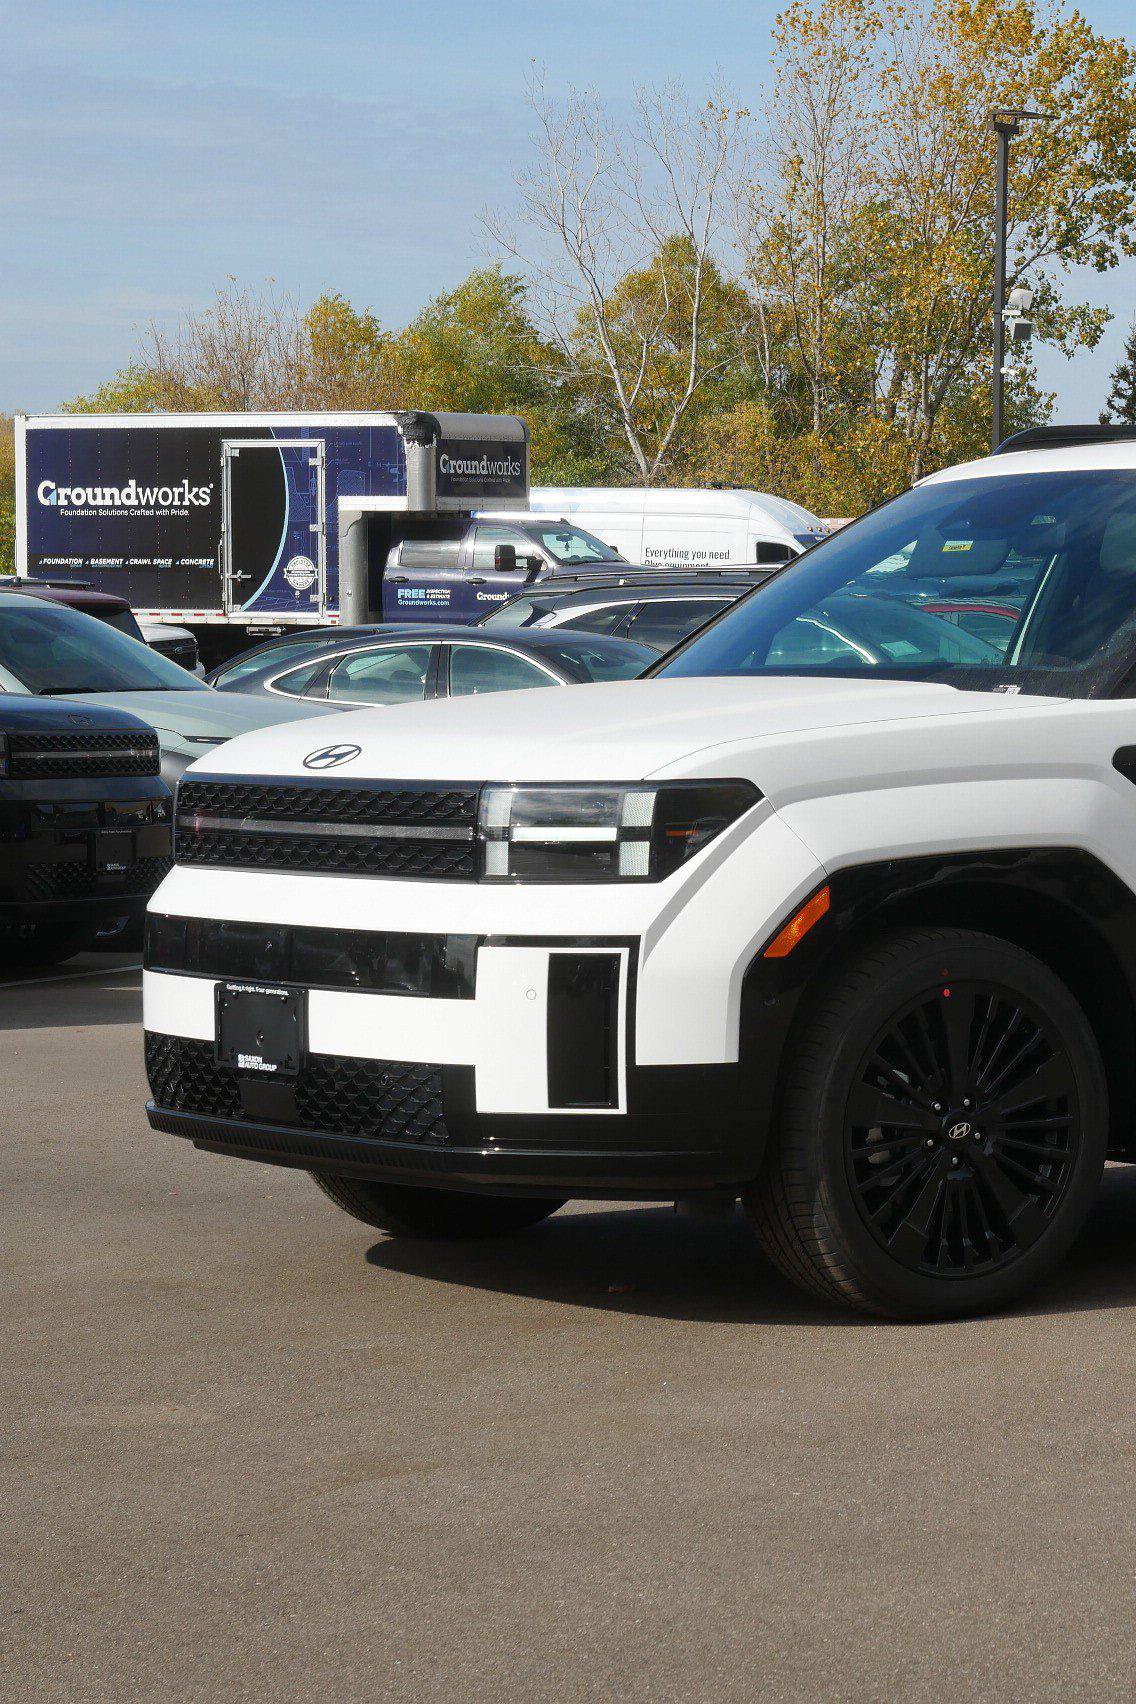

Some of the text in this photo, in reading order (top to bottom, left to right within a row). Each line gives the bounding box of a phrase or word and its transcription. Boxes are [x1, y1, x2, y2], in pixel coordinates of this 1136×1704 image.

[440, 453, 521, 476] Groundworks
[37, 480, 213, 506] Groundworks
[60, 508, 190, 516] Foundation Solutions Crafted with Pride.
[645, 547, 690, 560] Everything
[692, 550, 707, 560] you
[397, 588, 426, 599] FREE
[259, 1063, 277, 1071] GROUP
